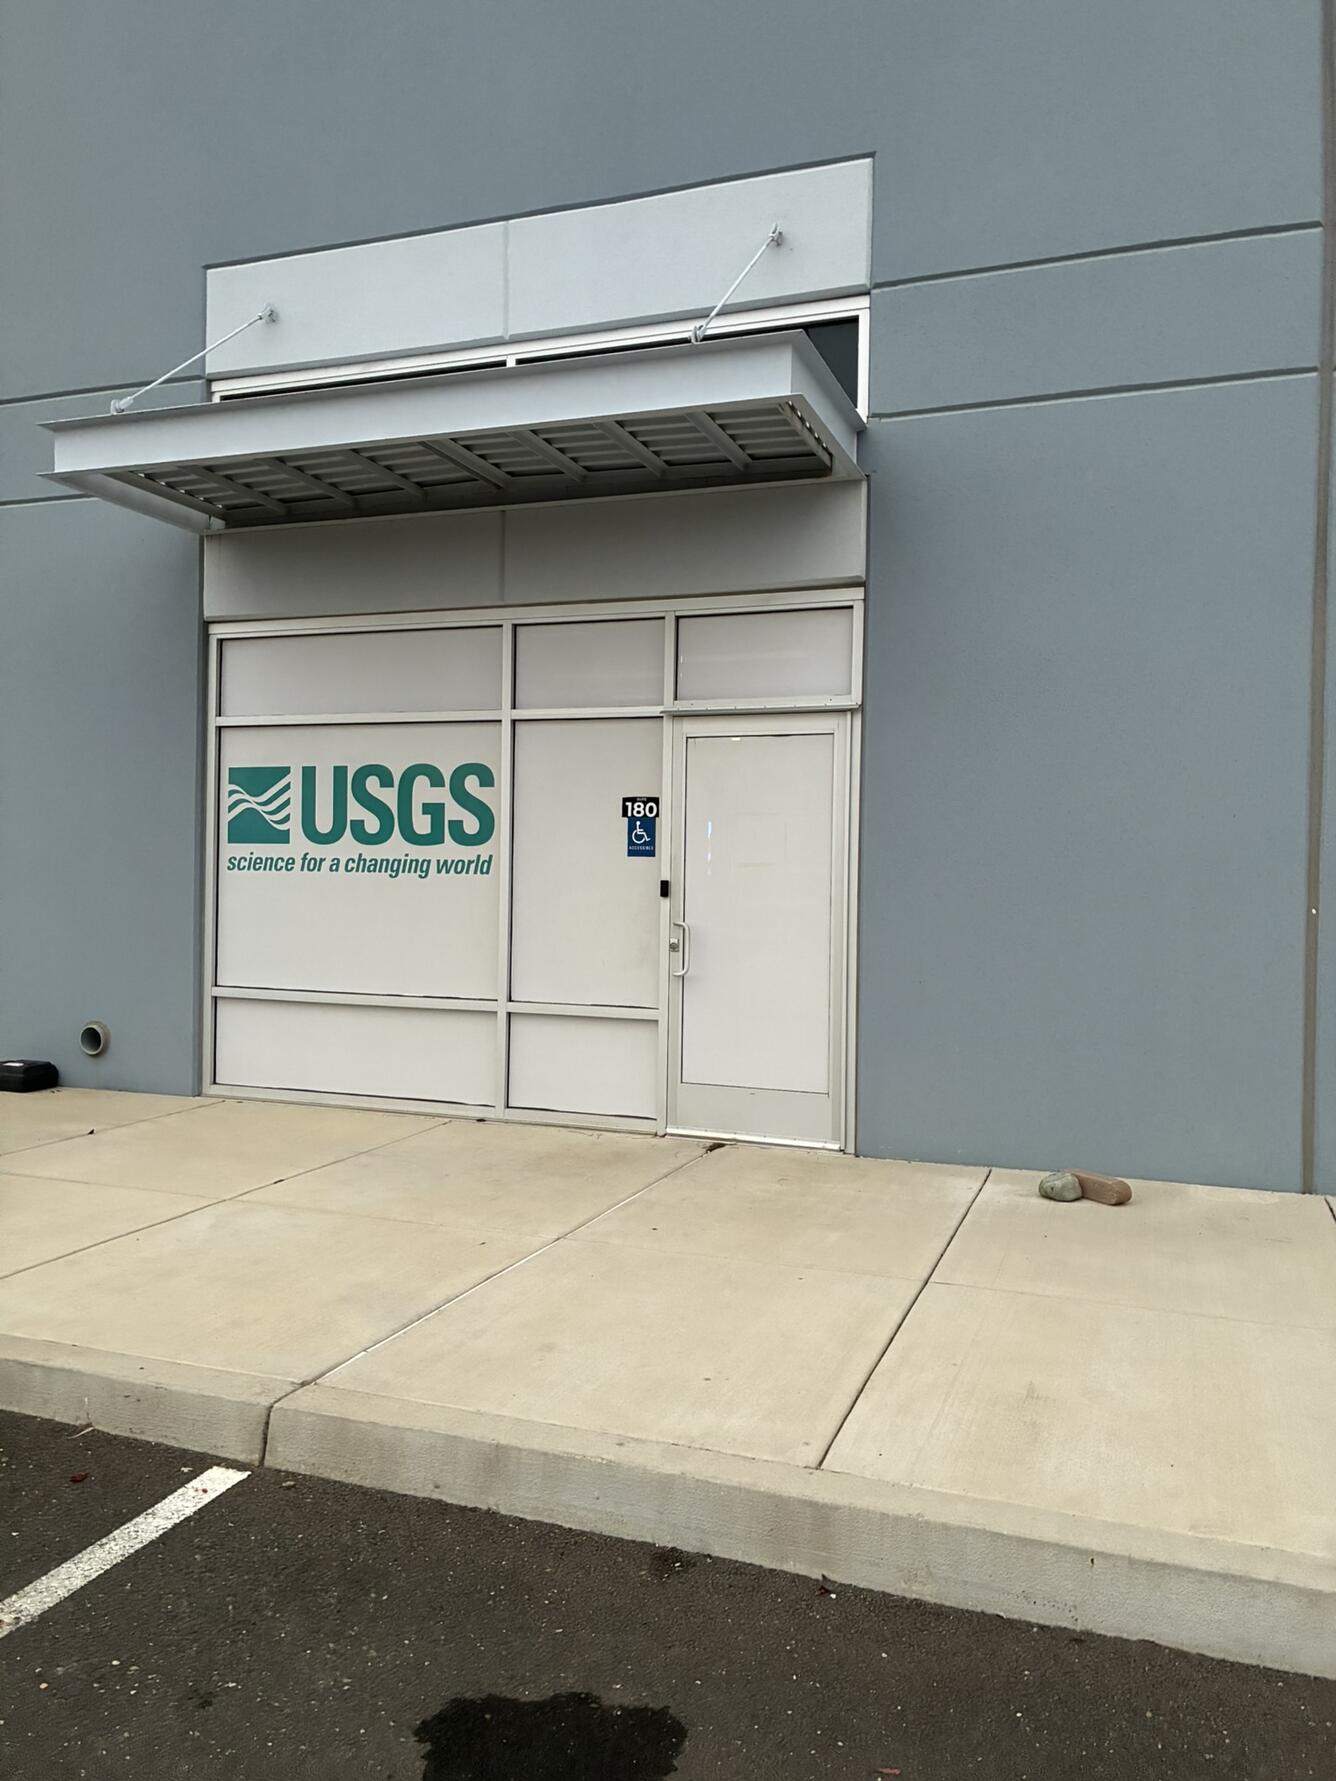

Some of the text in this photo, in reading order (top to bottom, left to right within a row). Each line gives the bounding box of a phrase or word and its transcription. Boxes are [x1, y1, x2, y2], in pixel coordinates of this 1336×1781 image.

[301, 762, 496, 847] USGS
[625, 801, 657, 817] 180
[226, 851, 494, 879] science for a changing world
